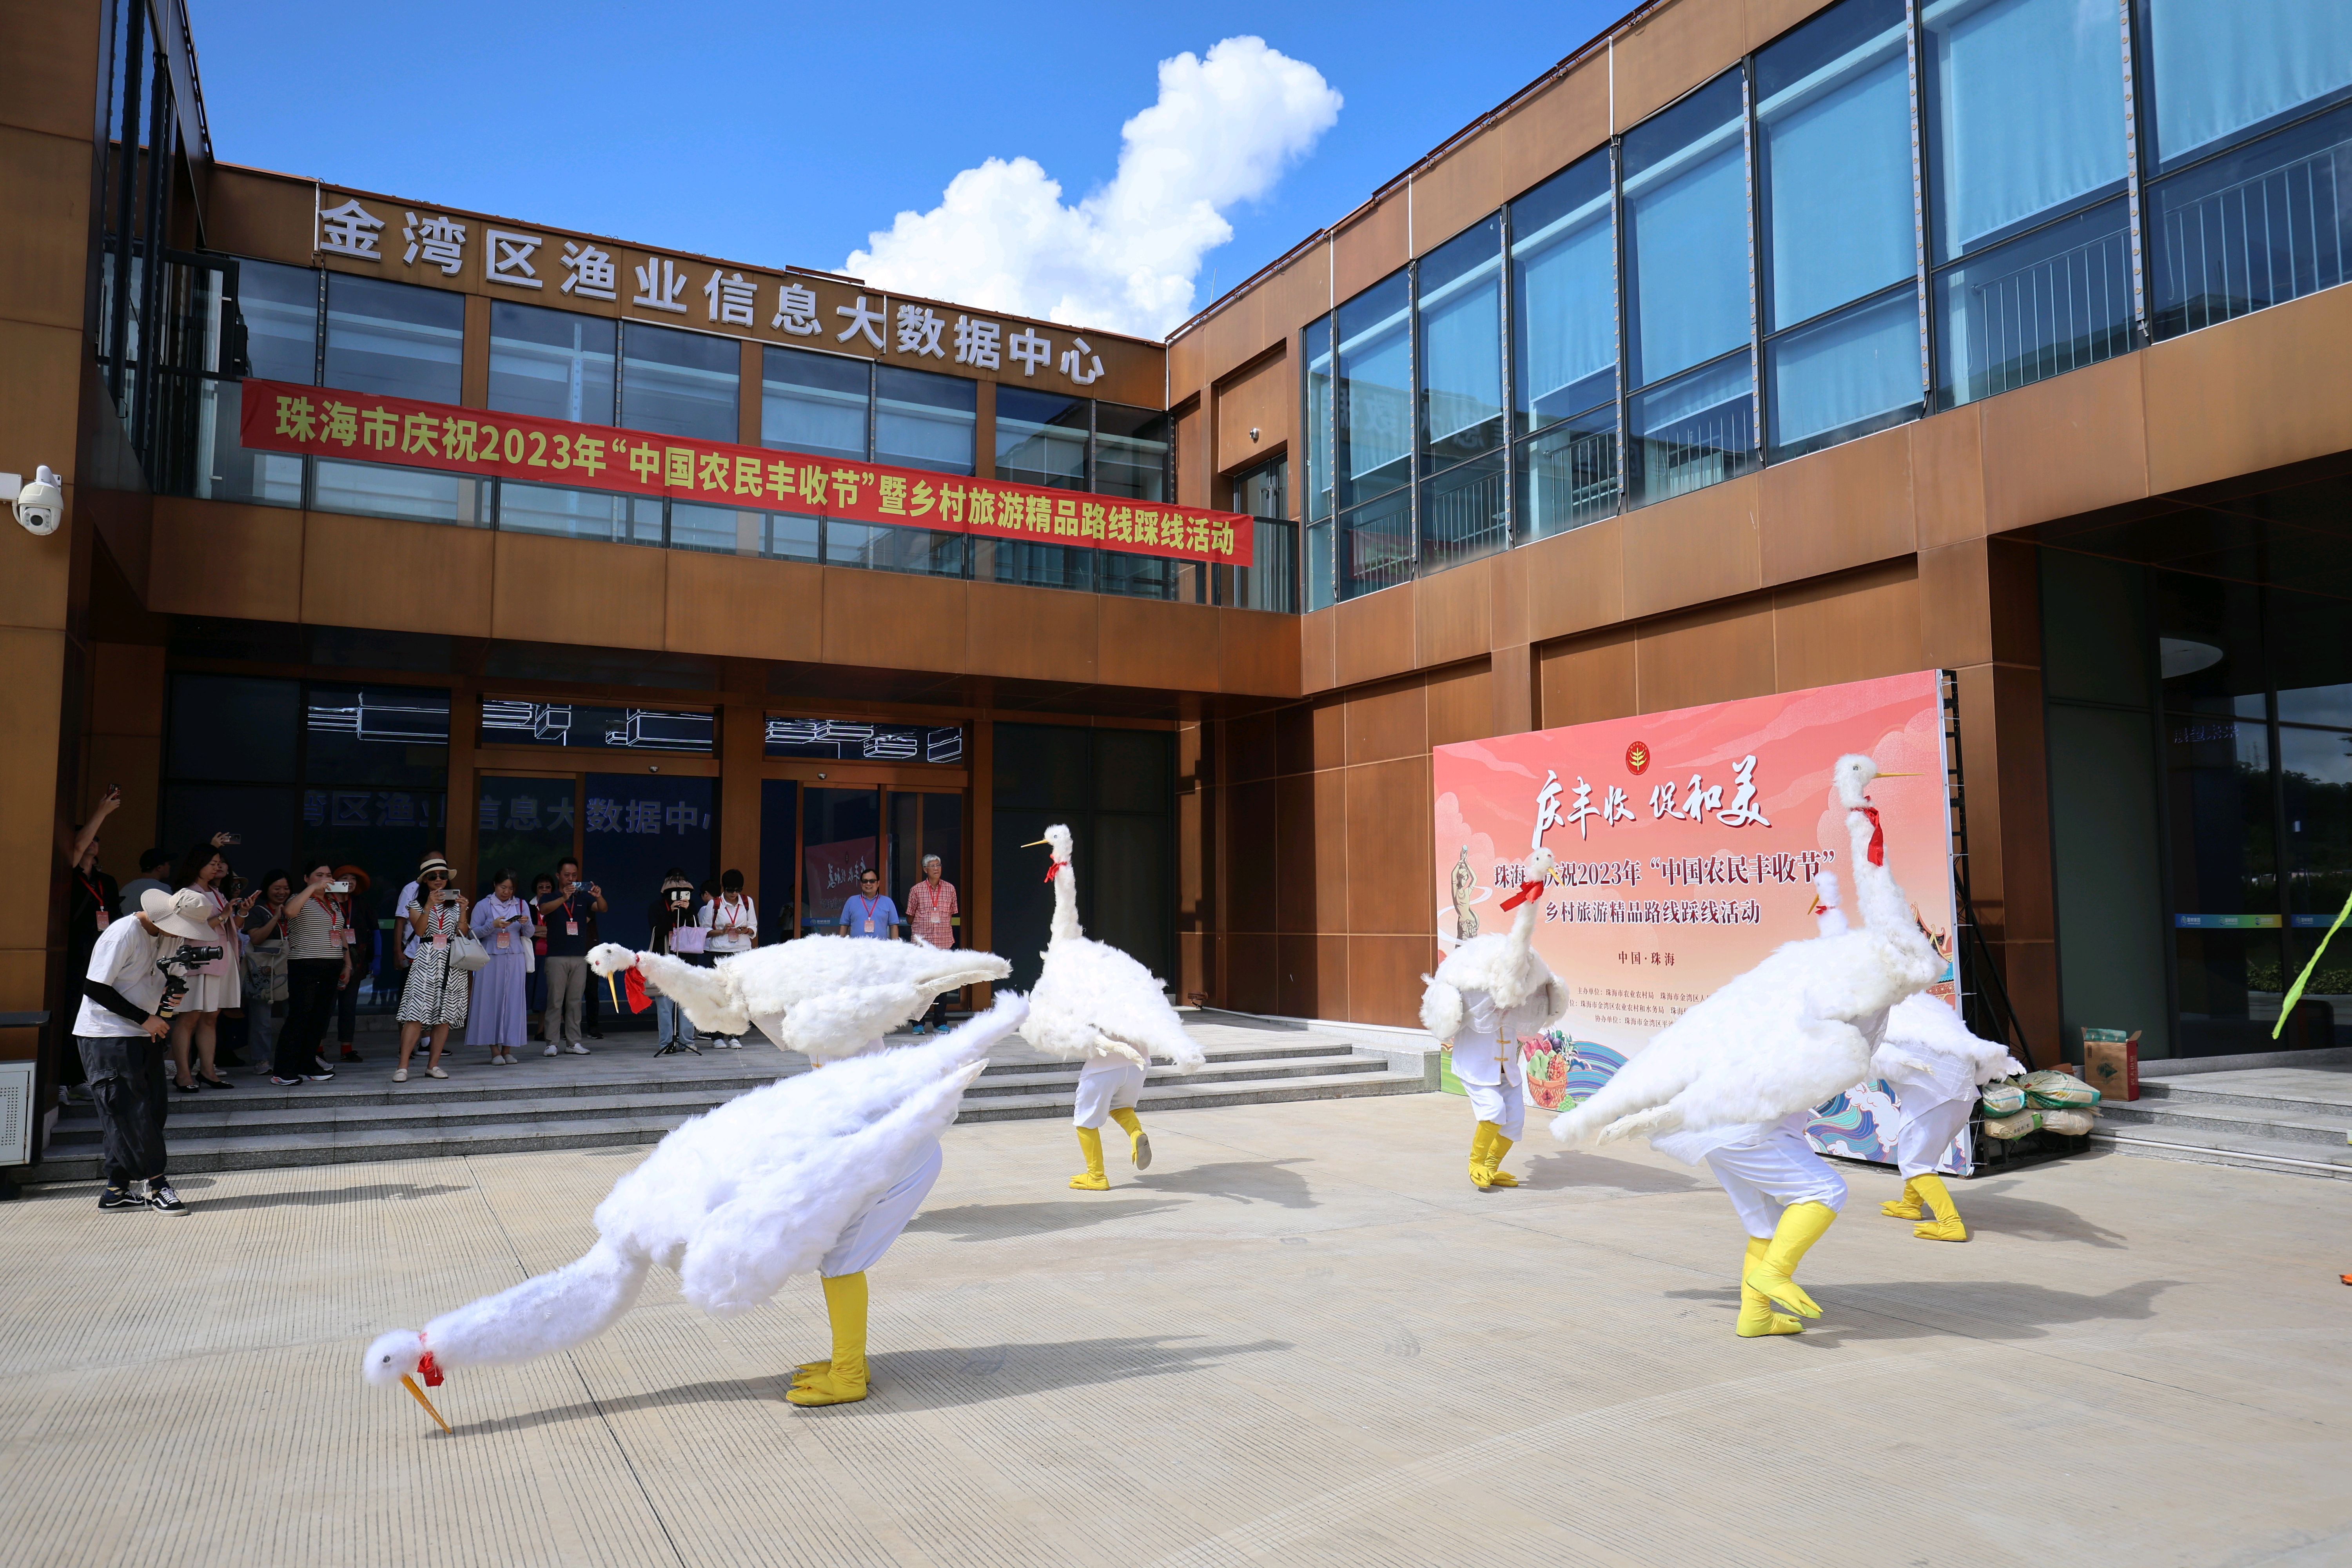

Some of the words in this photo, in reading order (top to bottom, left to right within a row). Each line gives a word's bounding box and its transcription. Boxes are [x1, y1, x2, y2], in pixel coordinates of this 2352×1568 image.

[319, 199, 1104, 386] 金湾区渔业信息大数据中心
[276, 396, 1234, 556] 珠海市庆祝2023年“中国农民丰收节”暨乡村旅游精品路线踩线活动
[1545, 899, 1760, 924] 乡村旅游精品路线踩线活动
